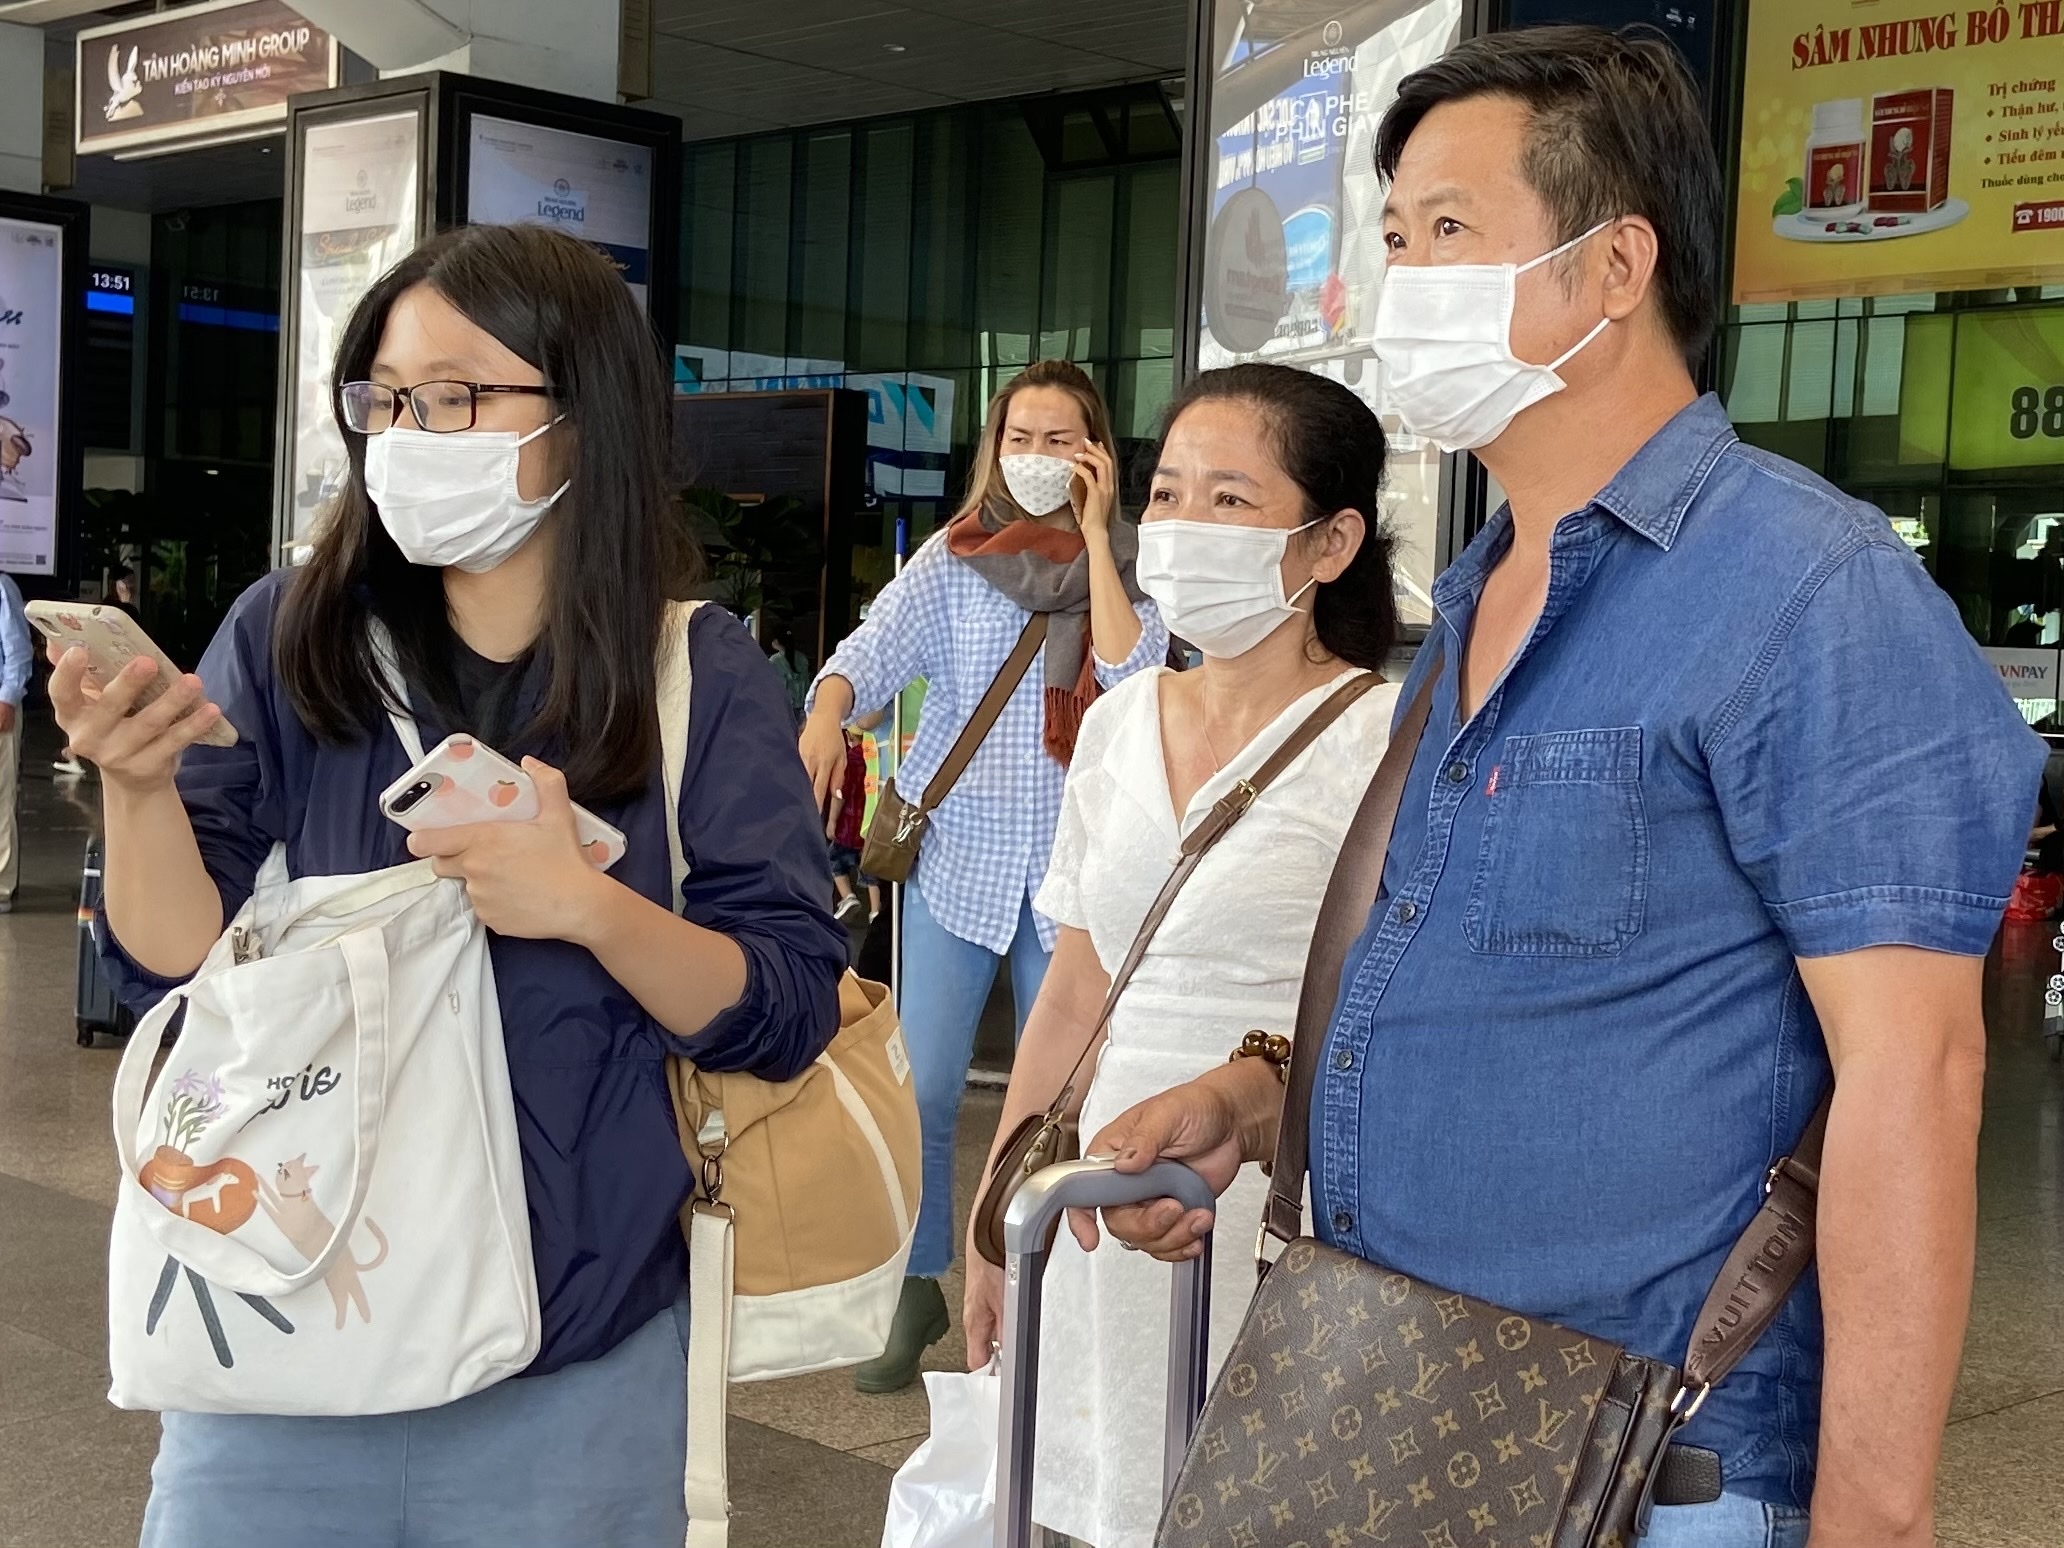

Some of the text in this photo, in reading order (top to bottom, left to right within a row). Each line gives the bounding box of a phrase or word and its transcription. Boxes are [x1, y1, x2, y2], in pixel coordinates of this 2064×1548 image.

[1792, 24, 1852, 71] SÂM
[1856, 12, 1959, 60] NHUNG
[2018, 0, 2064, 39] TH
[170, 44, 219, 77] HOÀNG
[222, 37, 256, 67] MINH
[259, 27, 310, 58] GROUP
[1303, 50, 1359, 80] Legend
[1998, 127, 2029, 143] Sinh
[1981, 174, 2014, 188] Thuốc
[345, 194, 377, 214] Legend
[537, 201, 585, 222] Legend
[92, 273, 130, 291] 13:51
[2000, 665, 2048, 679] VNPAY
[1702, 1210, 1805, 1345] VUITTON
